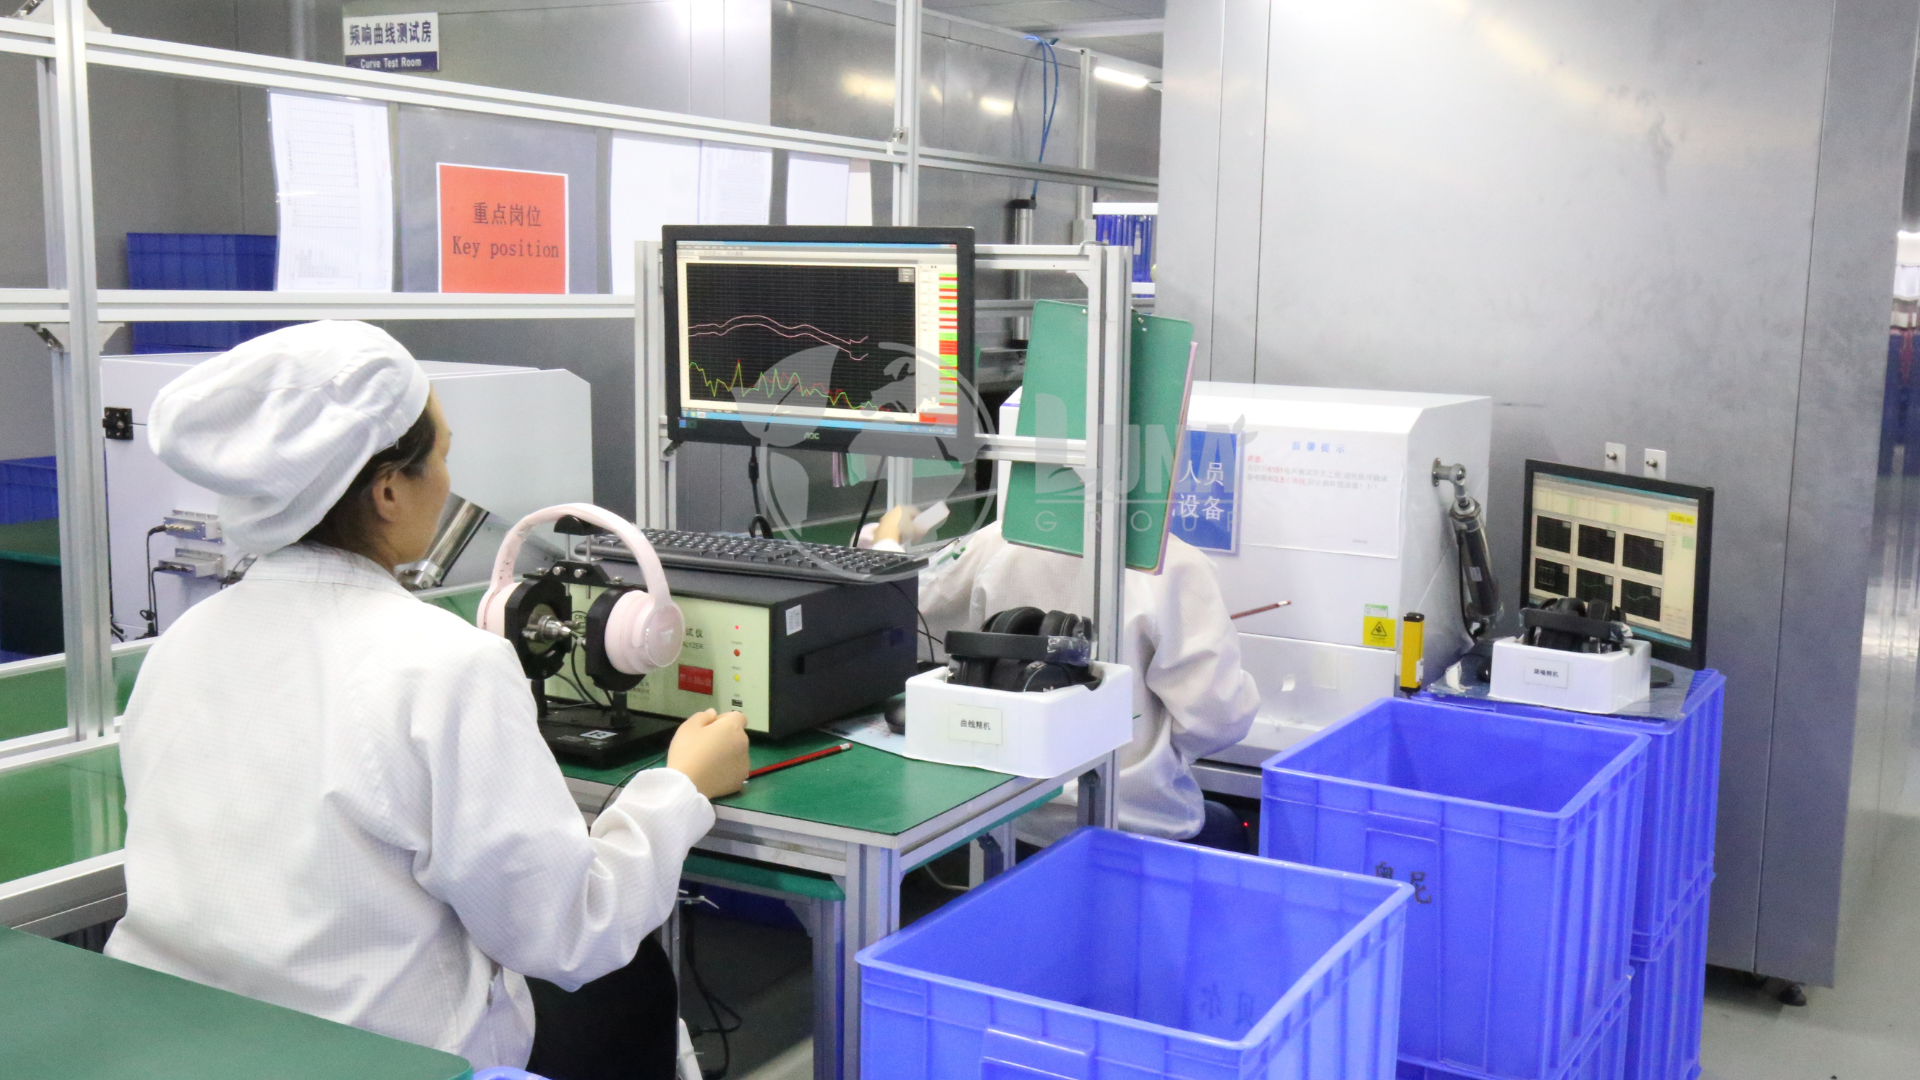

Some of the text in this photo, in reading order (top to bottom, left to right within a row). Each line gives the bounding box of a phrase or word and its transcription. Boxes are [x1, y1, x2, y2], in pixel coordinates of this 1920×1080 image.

[349, 20, 432, 46] 频响曲线测试房
[360, 56, 422, 69] Curve Test Room
[472, 201, 541, 227] 重点岗位
[452, 235, 560, 259] Key position
[1172, 493, 1225, 521] 设备
[685, 627, 704, 639] 试仪
